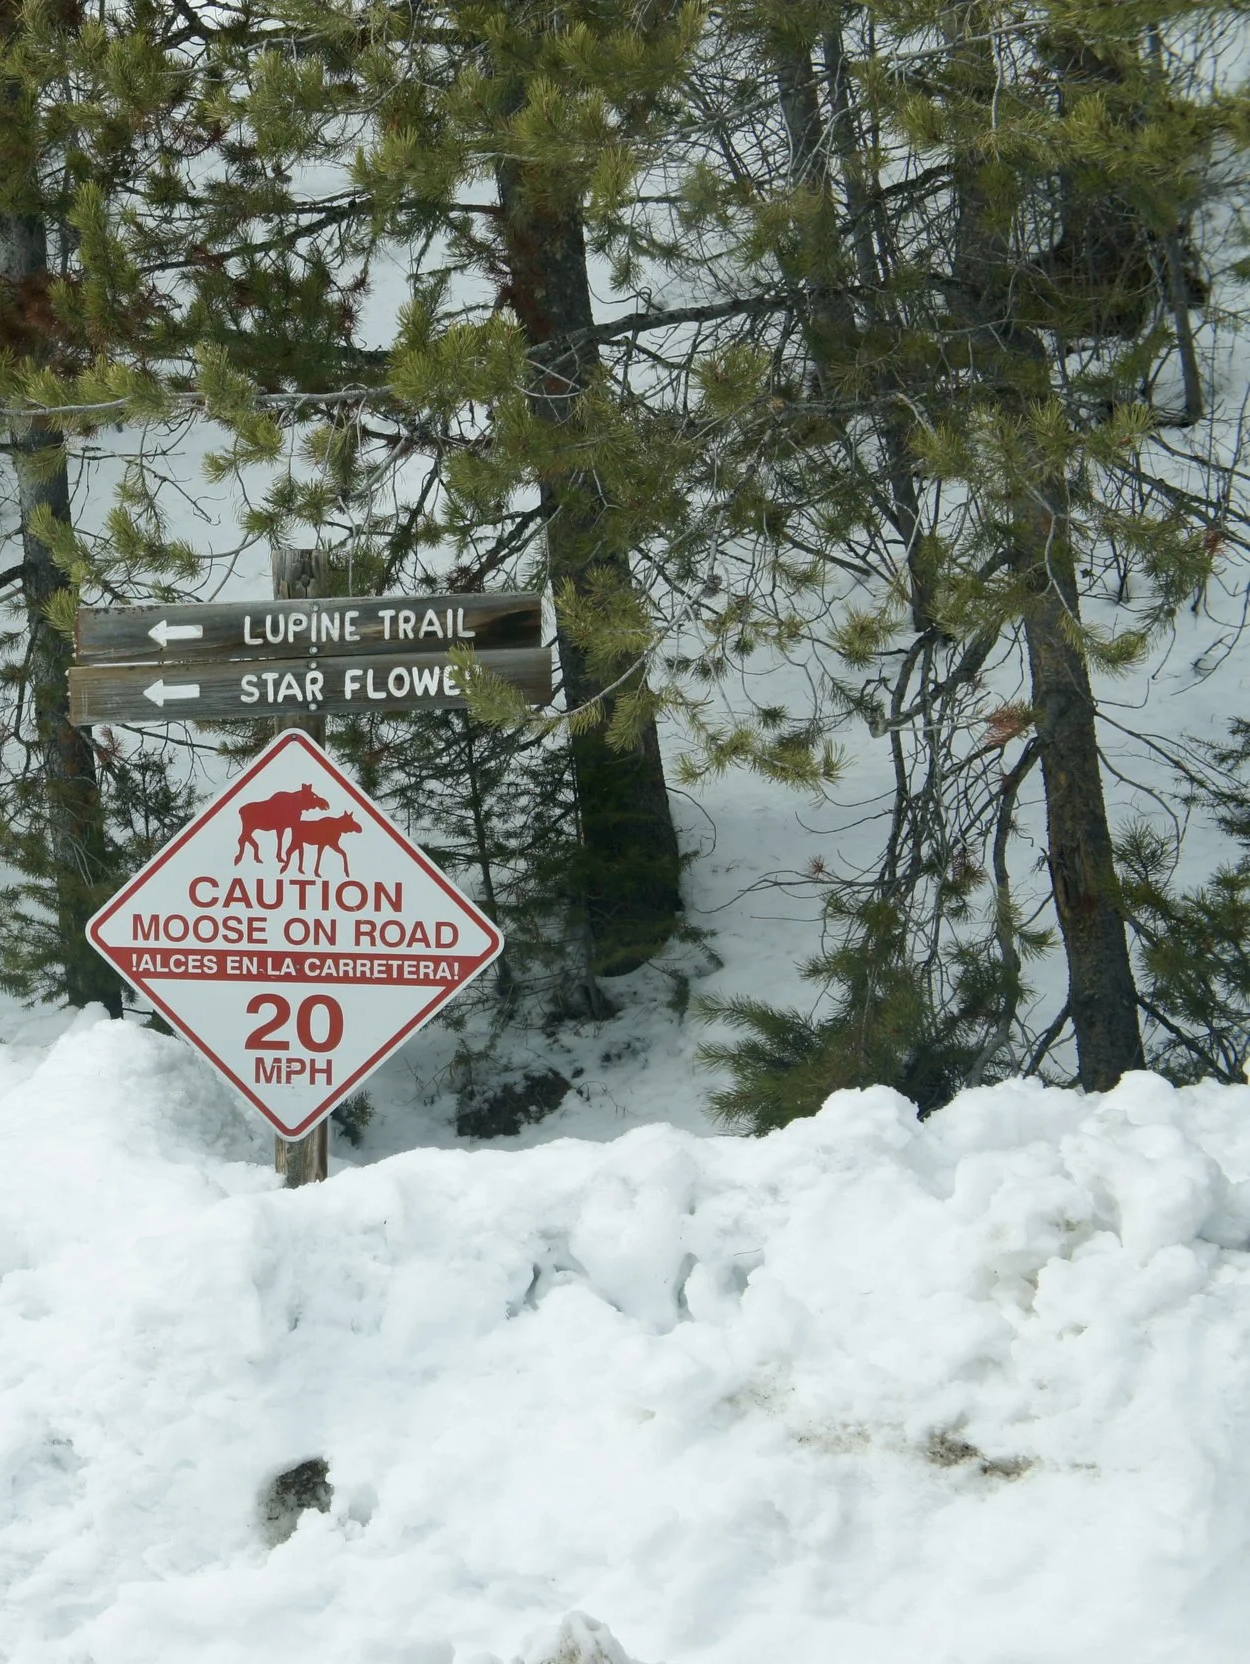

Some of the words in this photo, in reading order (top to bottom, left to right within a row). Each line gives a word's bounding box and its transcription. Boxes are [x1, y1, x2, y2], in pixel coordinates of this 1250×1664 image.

[243, 610, 359, 646] LUPINE
[379, 607, 476, 641] TRAIL
[240, 669, 324, 703] STAR
[344, 665, 483, 699] FLOWE
[188, 876, 403, 912] CAUTION
[132, 914, 268, 944] MOOSE
[283, 917, 337, 946] ON
[354, 919, 459, 949] ROAD
[226, 956, 258, 975] EN
[267, 957, 296, 976] LA
[304, 958, 459, 980] CARRETERA!
[244, 993, 344, 1053] 20
[254, 1057, 333, 1086] MPH
